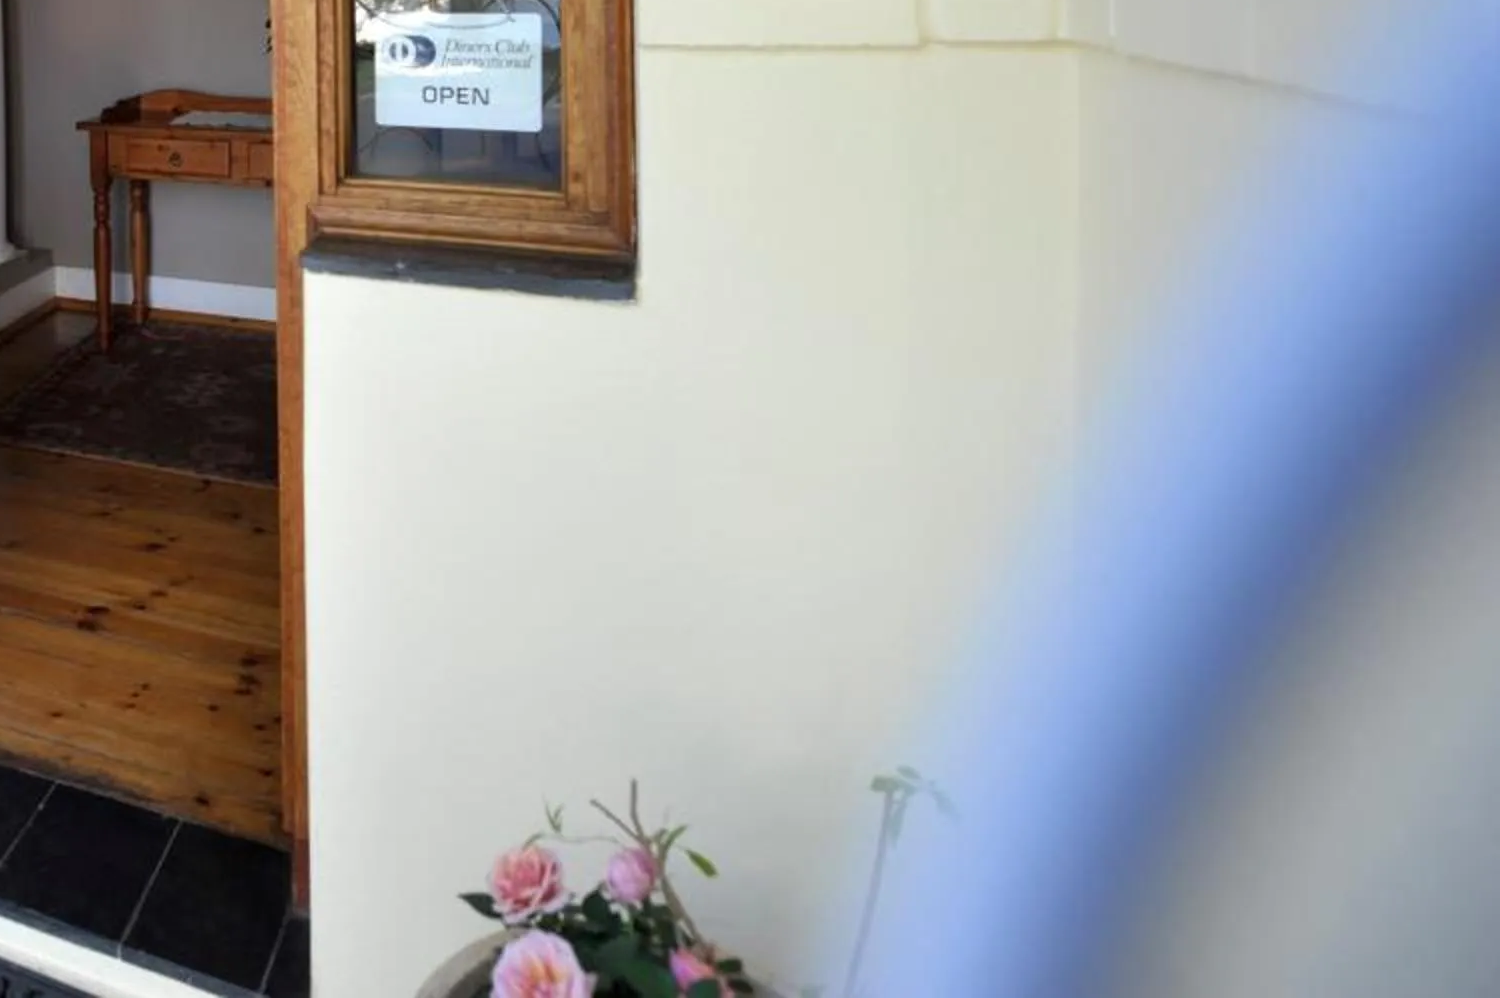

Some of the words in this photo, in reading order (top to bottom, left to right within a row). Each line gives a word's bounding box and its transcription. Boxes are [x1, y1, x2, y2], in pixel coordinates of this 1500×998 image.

[445, 38, 491, 53] Diners
[495, 38, 531, 53] Club
[440, 53, 533, 69] International
[422, 85, 490, 106] OPEN
